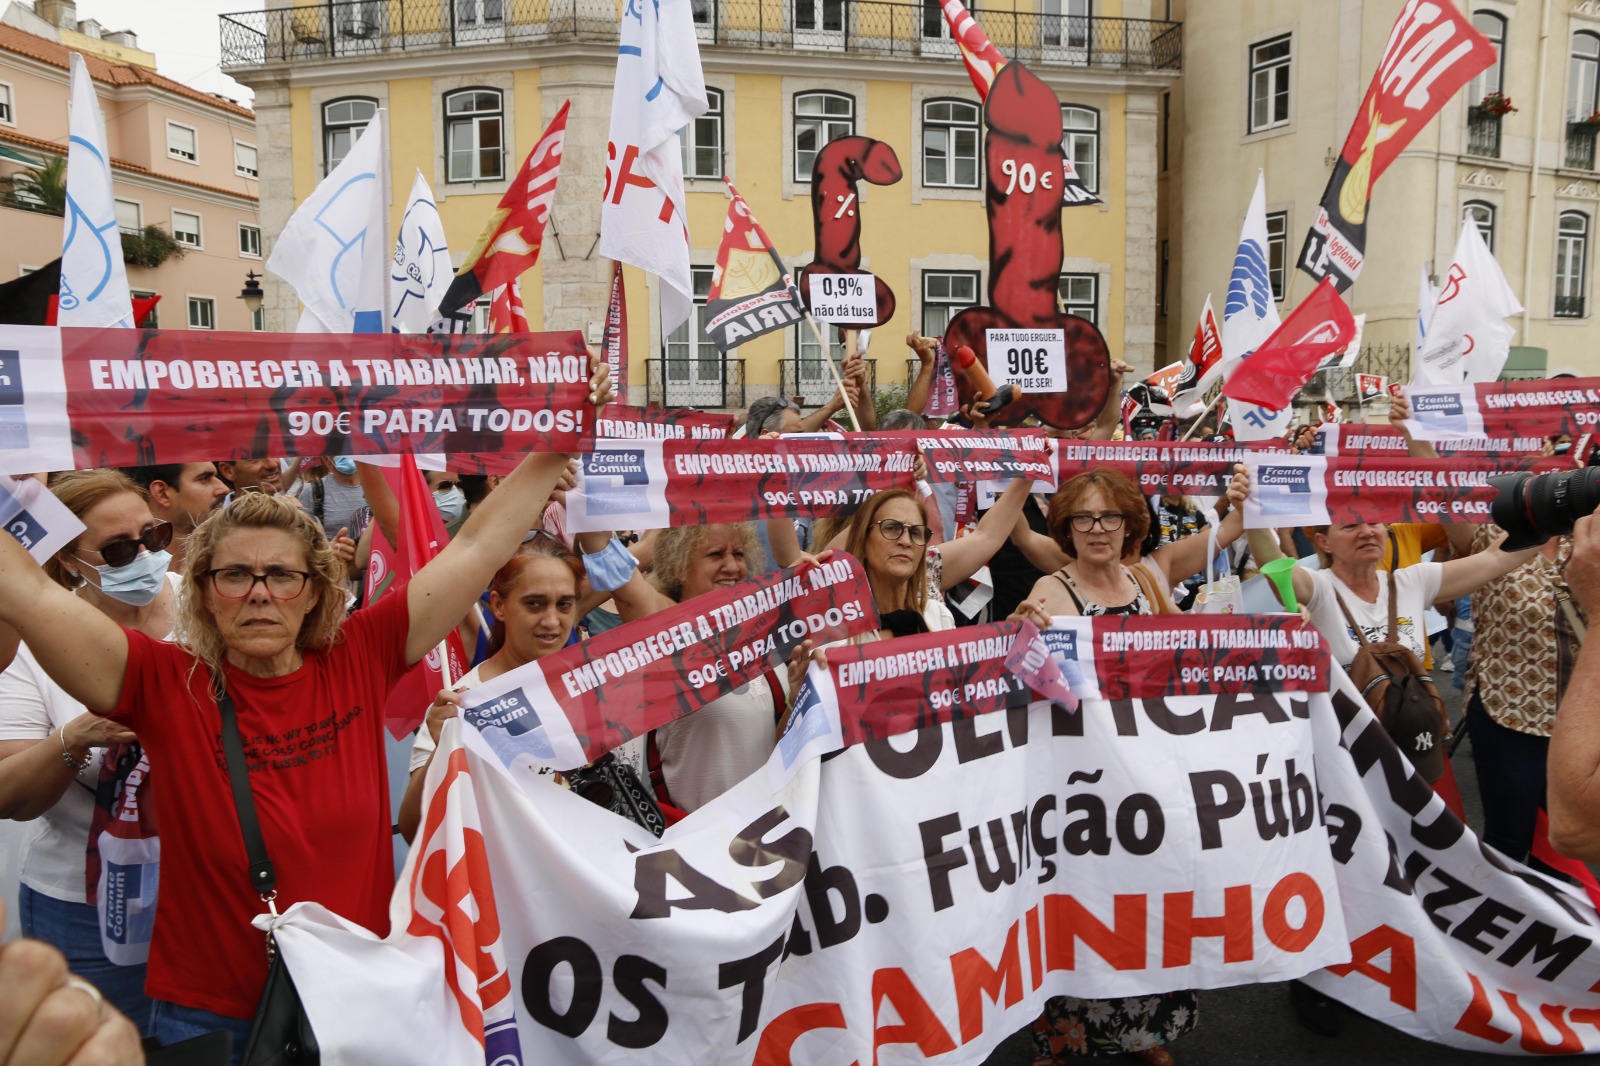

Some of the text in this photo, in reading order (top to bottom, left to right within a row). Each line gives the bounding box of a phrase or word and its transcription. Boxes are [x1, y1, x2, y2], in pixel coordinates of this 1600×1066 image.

[1001, 159, 1053, 196] 90€
[822, 277, 863, 299] 0,9%
[815, 303, 874, 317] não dá tusa
[990, 333, 1063, 342] PARA TUDO ERGUER...
[89, 351, 589, 390] EMPOBRECER A TRABALHAR, NÃO!
[1007, 347, 1049, 376] 90€
[1024, 378, 1034, 388] DE
[1035, 378, 1053, 388] SER!
[1416, 402, 1460, 411] Comum
[1418, 395, 1455, 404] Frente
[1485, 389, 1600, 409] EMPOBRECER A
[287, 408, 583, 436] 90€ PARA TODOS!
[940, 438, 952, 449] A
[949, 437, 1021, 451] TRABALHAR,
[1021, 435, 1046, 451] NÃO!
[592, 452, 638, 463] Frente
[1067, 445, 1159, 462] EMPOBRECER
[1160, 447, 1170, 462] A
[588, 463, 642, 473] Comum
[674, 451, 916, 475] EMPOBRECER A TRABALHAR, NÃO!
[935, 461, 1051, 475] 90€ PARA TODOS!
[1265, 467, 1304, 475] Frente
[1140, 474, 1168, 486] 90€
[1172, 474, 1218, 487] PARA
[1261, 475, 1306, 484] Comum
[1334, 470, 1433, 487] EMPOBRECER
[1436, 471, 1447, 487] A
[764, 492, 798, 506] 90€
[800, 489, 848, 506] PARA
[1416, 501, 1449, 514] 90€
[561, 558, 855, 698] EMPOBRECER A TRABALHAR, NÃO!
[687, 600, 865, 689] 90€ PARA TODOS!
[1103, 631, 1196, 652] EMPOBRECER
[1199, 630, 1208, 650] A
[1211, 629, 1291, 650] TRABALHAR,
[838, 650, 944, 688] EMPOBRECER
[947, 650, 959, 668] A
[1181, 668, 1209, 684] 90€
[1214, 665, 1259, 682] PARA
[929, 688, 961, 710] 90€
[965, 677, 1010, 703] PARA
[114, 872, 126, 938] Comum
[521, 935, 670, 1050] OS
[919, 768, 1166, 914] Função
[750, 871, 1326, 1066] CAMINHO
[1324, 924, 1418, 1013] A
